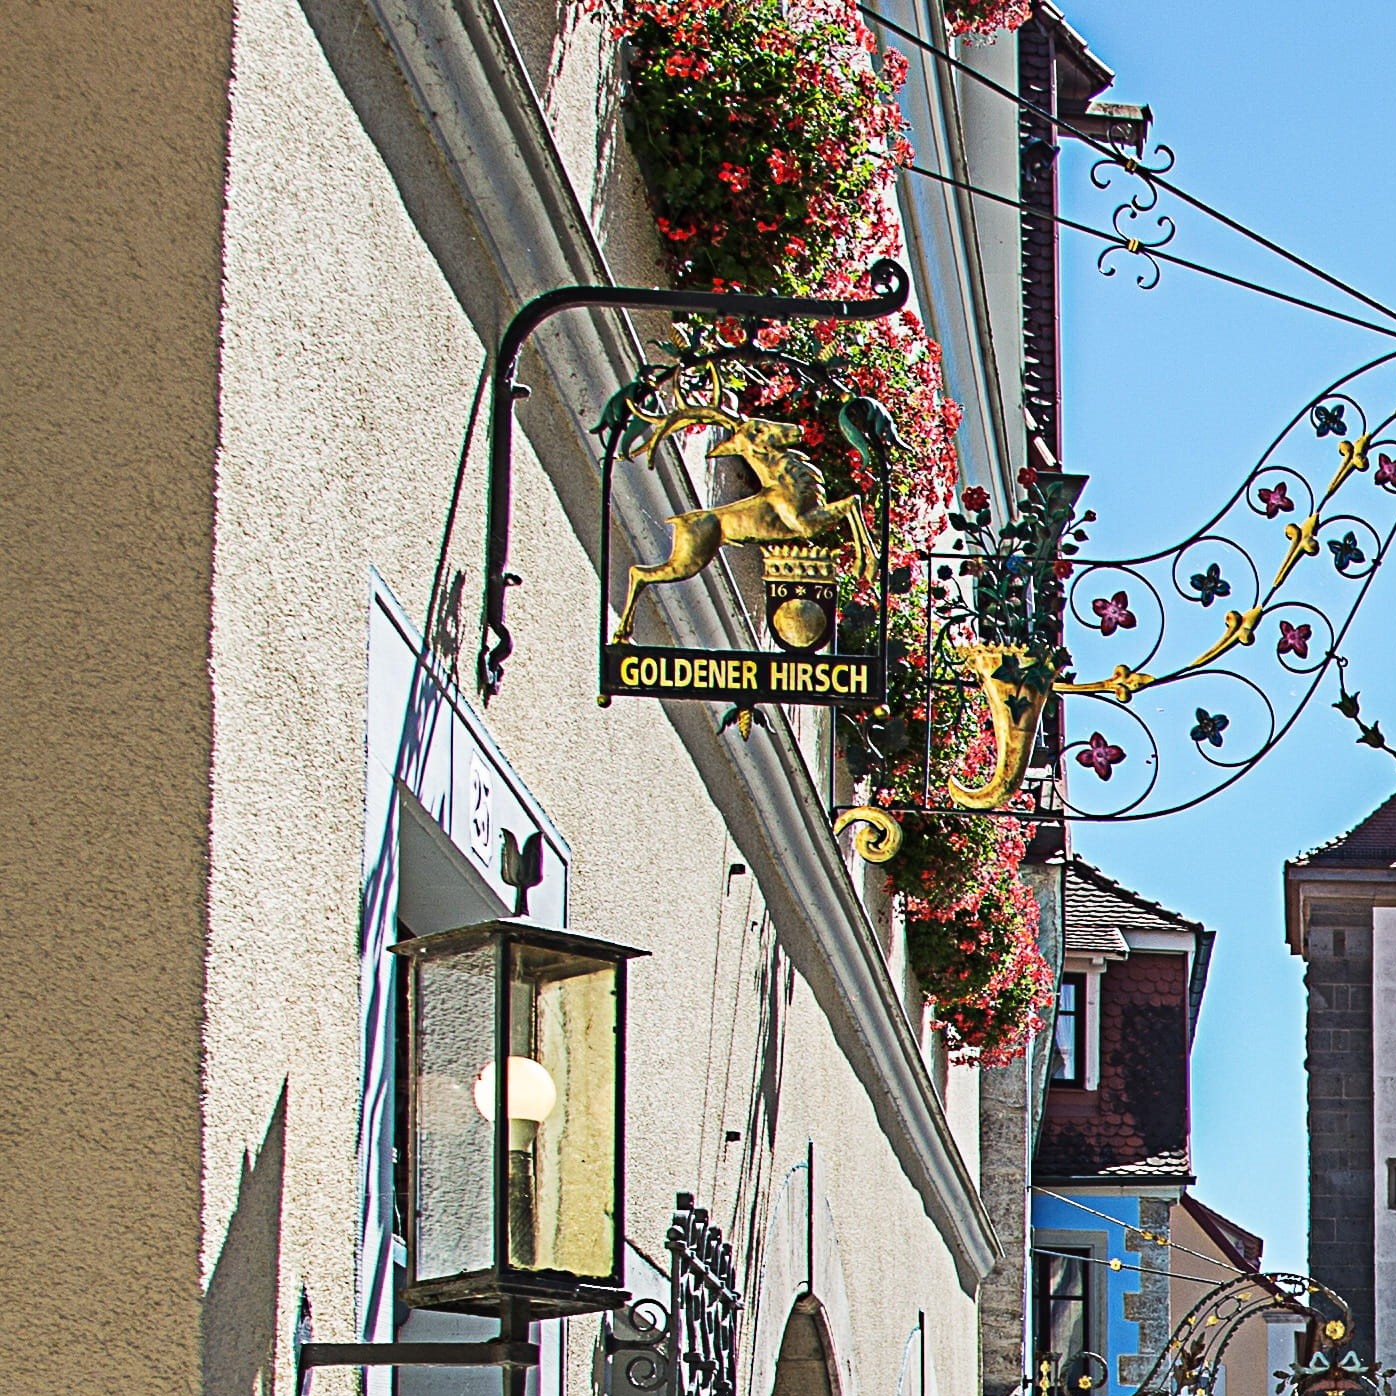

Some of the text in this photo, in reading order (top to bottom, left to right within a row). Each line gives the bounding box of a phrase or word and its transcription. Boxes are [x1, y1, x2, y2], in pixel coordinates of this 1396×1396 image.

[769, 583, 834, 600] 16 76
[619, 656, 869, 694] GOLDENER HIRSCH
